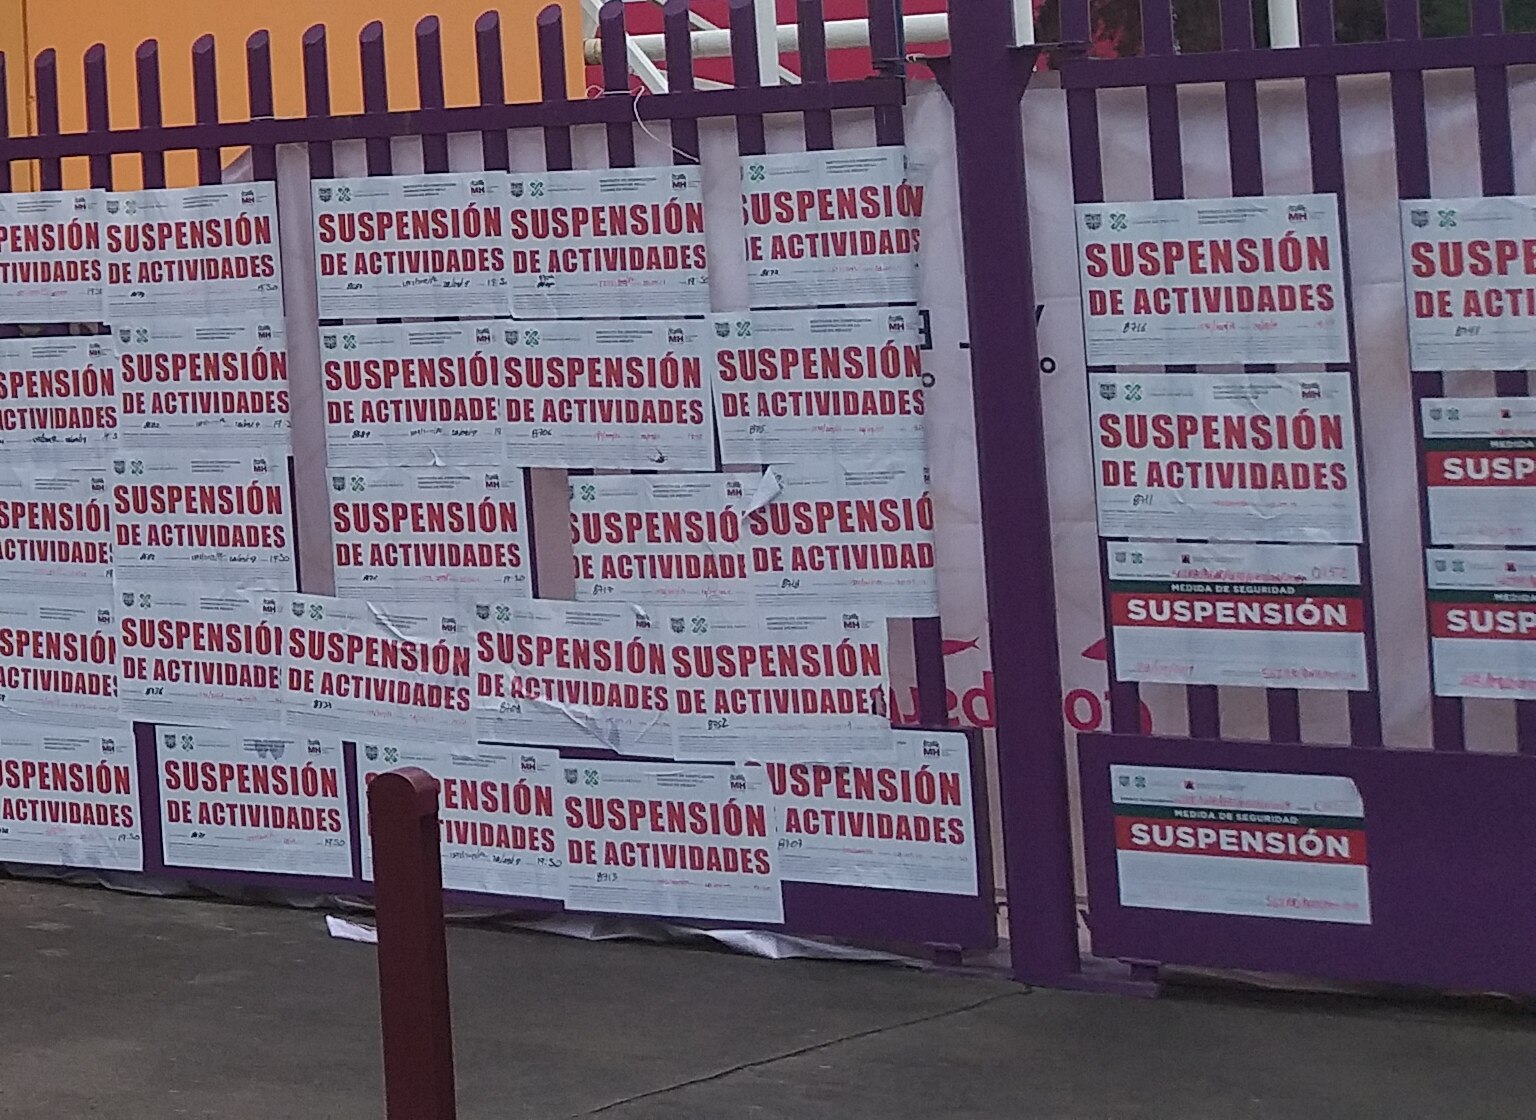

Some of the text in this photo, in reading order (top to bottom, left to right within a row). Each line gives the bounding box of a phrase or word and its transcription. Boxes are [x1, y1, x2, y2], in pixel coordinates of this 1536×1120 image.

[108, 212, 270, 253] SUSPENSIÓN
[319, 204, 501, 243] SUSPENSIÓN
[511, 199, 703, 240] SUSPENSIÓN
[109, 255, 274, 284] DE ACTIVIDADES
[321, 248, 504, 275] DE ACTIVIDADES
[514, 245, 705, 273] DE ACTIVIDADES
[1086, 231, 1328, 277] SUSPENSIÓN
[1090, 284, 1333, 315] DE ACTIVIDADES
[1416, 291, 1451, 317] DE
[122, 349, 287, 382] SUSPENSIÓN
[504, 353, 700, 388] SUSPENSIÓN
[718, 341, 921, 381] SUSPENSIÓN
[124, 391, 288, 414] DE ACTIVIDADES
[507, 400, 703, 423] DE ACTIVIDADES
[723, 391, 923, 416] DE ACTIVIDADES
[1100, 411, 1342, 449] SUSPENSIÓN
[1103, 461, 1346, 489] DE ACTIVIDADES
[115, 482, 281, 514] SUSPENSIÓN
[333, 495, 517, 532] SUSPENSIÓN
[117, 525, 284, 547] DE ACTIVIDADES
[337, 544, 520, 566] DE ACTIVIDADES
[1171, 584, 1295, 595] MEDIDA DE SEGURIDAD
[1127, 598, 1347, 626] SUSPENSIÓN
[290, 628, 469, 676] SUSPENSIÓN
[477, 632, 665, 674] SUSPENSIÓN
[673, 639, 880, 678] SUSPENSIÓN
[289, 669, 469, 711] DE ACTIVIDADES
[479, 674, 668, 711] DE ACTIVIDADES
[677, 690, 704, 713] DE
[165, 761, 337, 797] SUSPENSIÓN
[3, 799, 133, 827] ACTIVIDADES
[168, 800, 340, 832] DE ACTIVIDADES
[565, 797, 766, 837] SUSPENSIÓN
[786, 808, 964, 844] ACTIVIDADES
[1174, 809, 1298, 825] MEDIDA DE SEGURIDAD
[569, 840, 769, 873] DE ACTIVIDADES
[1130, 824, 1349, 857] SUSPENSIÓN
